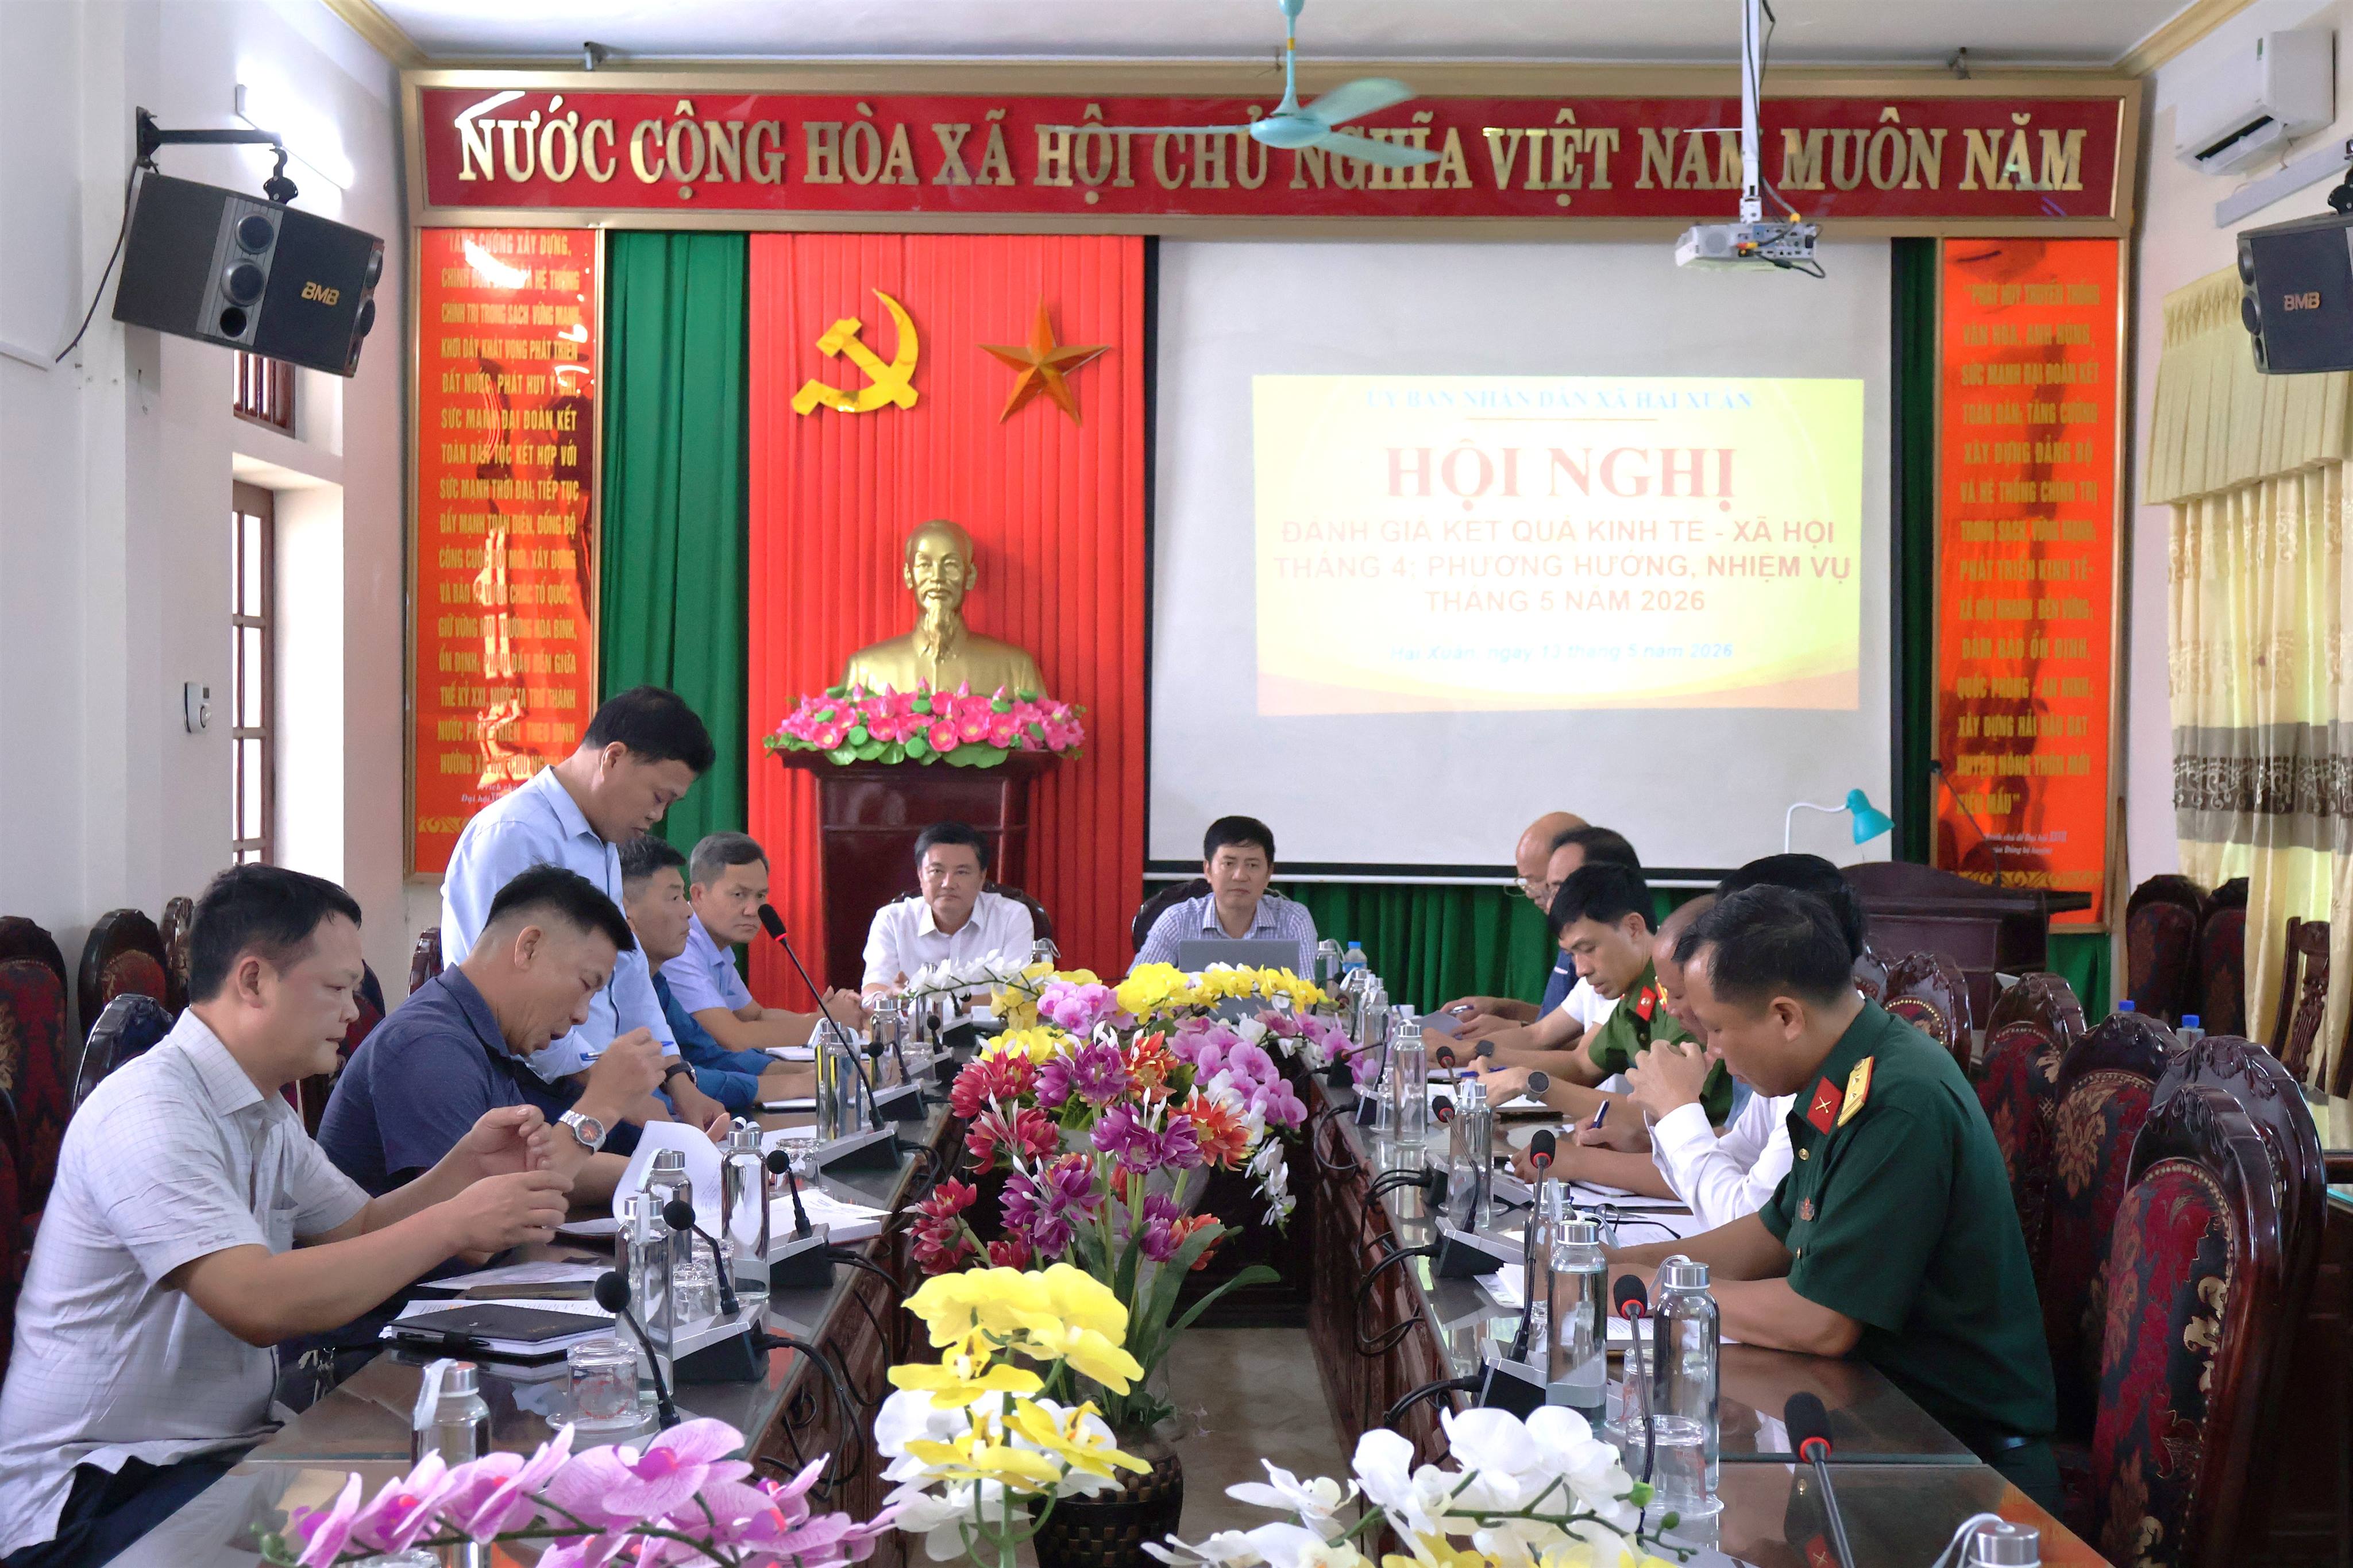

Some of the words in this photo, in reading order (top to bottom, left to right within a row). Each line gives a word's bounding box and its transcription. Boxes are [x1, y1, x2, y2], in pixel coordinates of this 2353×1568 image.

[454, 94, 616, 184] NƯỚC
[630, 100, 785, 199] CỘNG
[803, 102, 919, 186] HÒA
[931, 108, 1015, 187] XÃ
[1035, 103, 1135, 205] HỘI
[1154, 105, 1268, 190] CHỦ
[1483, 108, 1619, 207] VIỆT
[1634, 126, 1744, 190] NAM
[1779, 106, 1947, 191] MUÔN
[1958, 111, 2086, 192] NĂM
[302, 281, 340, 306] BMB
[2283, 291, 2321, 311] BMB
[497, 370, 523, 395] PHÁT
[527, 374, 546, 395] HUY
[1407, 390, 1455, 408] BAN
[523, 405, 554, 431] ĐOÀN
[557, 404, 577, 431] KẾT
[441, 440, 466, 464] TOÀN
[515, 439, 534, 465] KẾT
[537, 445, 557, 469] HỢP
[561, 438, 577, 466] VỚI
[1384, 438, 1522, 512] HỘI
[1546, 446, 1738, 512] NGHỊ
[561, 480, 579, 505] TỤC
[1587, 520, 1658, 543] KINH
[1733, 515, 1772, 543] XÃ
[1272, 551, 1380, 580] THÁNG
[1427, 554, 1564, 578] PHƯƠNG
[1574, 548, 1696, 581] HƯỚNG,
[1707, 553, 1802, 584] NHIỆM
[1810, 555, 1852, 585] VỤ
[1425, 584, 1529, 612] THÁNG
[1540, 590, 1555, 612] 5
[1641, 590, 1706, 612] 2026
[1689, 642, 1734, 658] 2026
